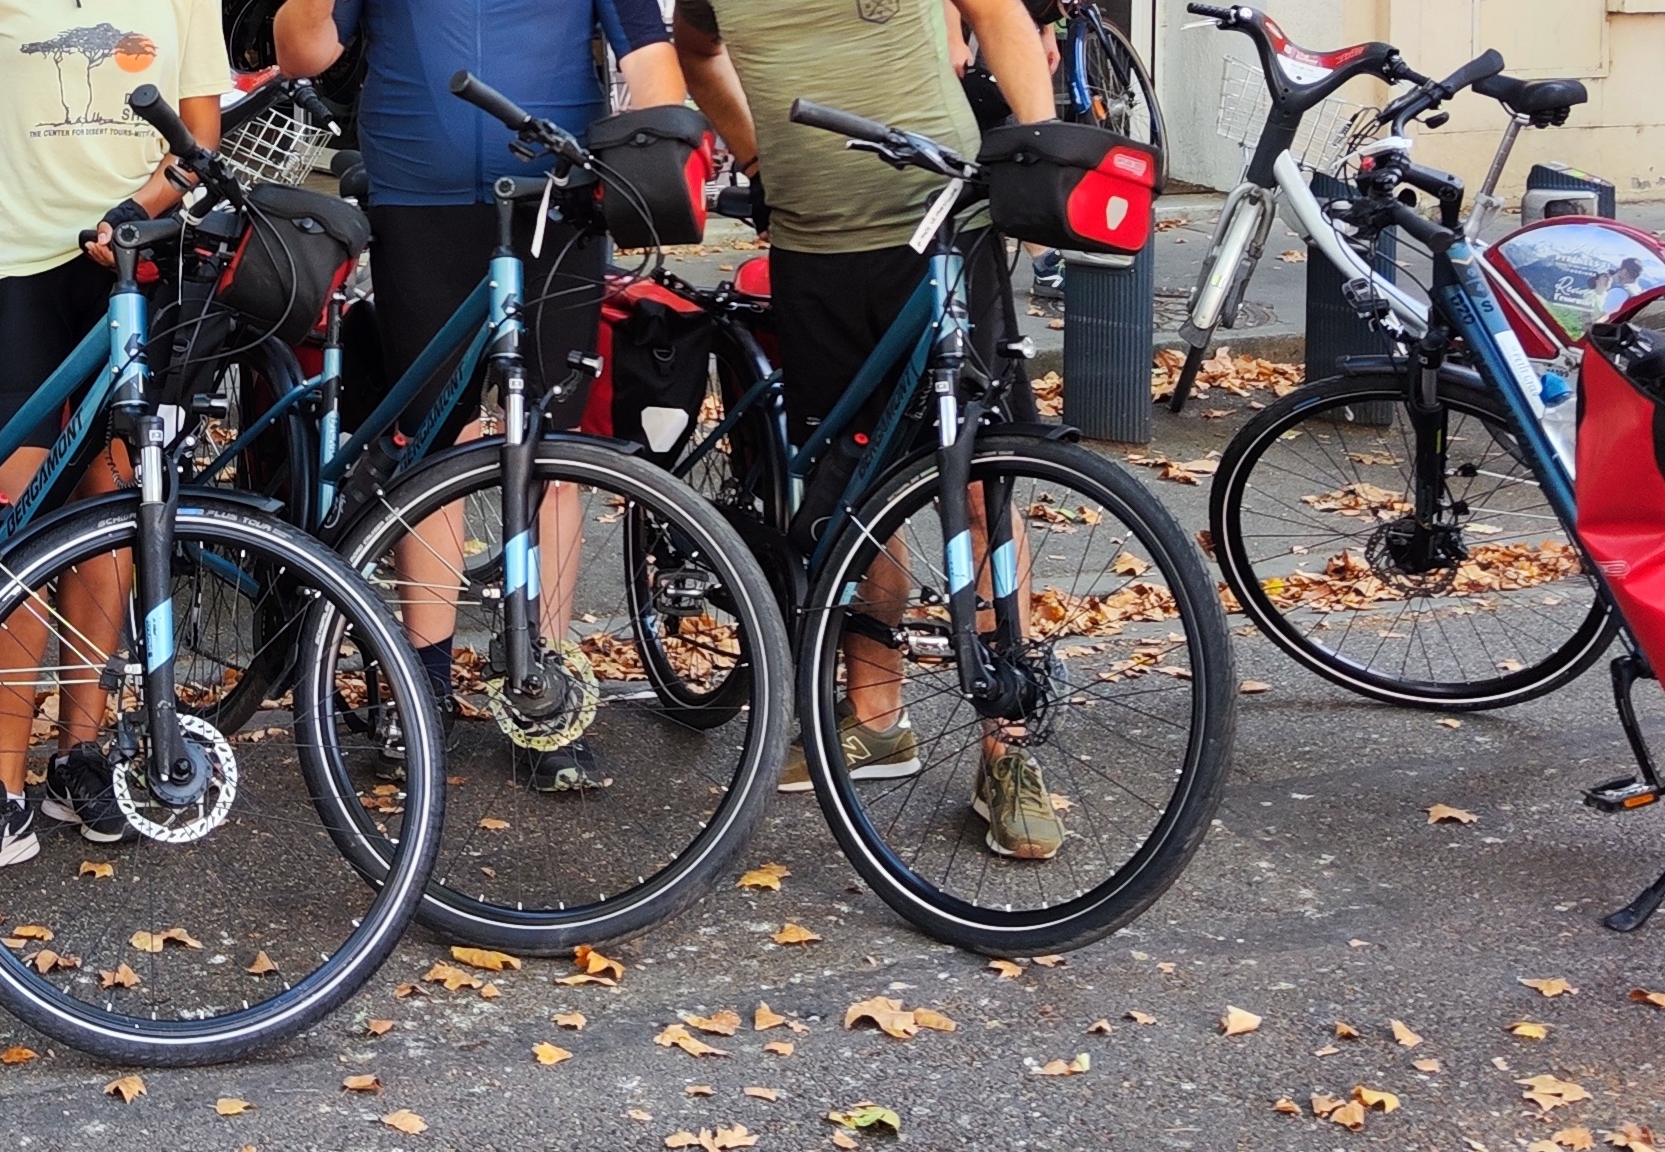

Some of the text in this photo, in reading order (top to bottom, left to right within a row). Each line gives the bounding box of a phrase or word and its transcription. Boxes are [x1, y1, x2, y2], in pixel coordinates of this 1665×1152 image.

[6, 408, 84, 536] BERGAMONT
[206, 509, 238, 521] PLUS
[243, 517, 272, 532] TOUR
